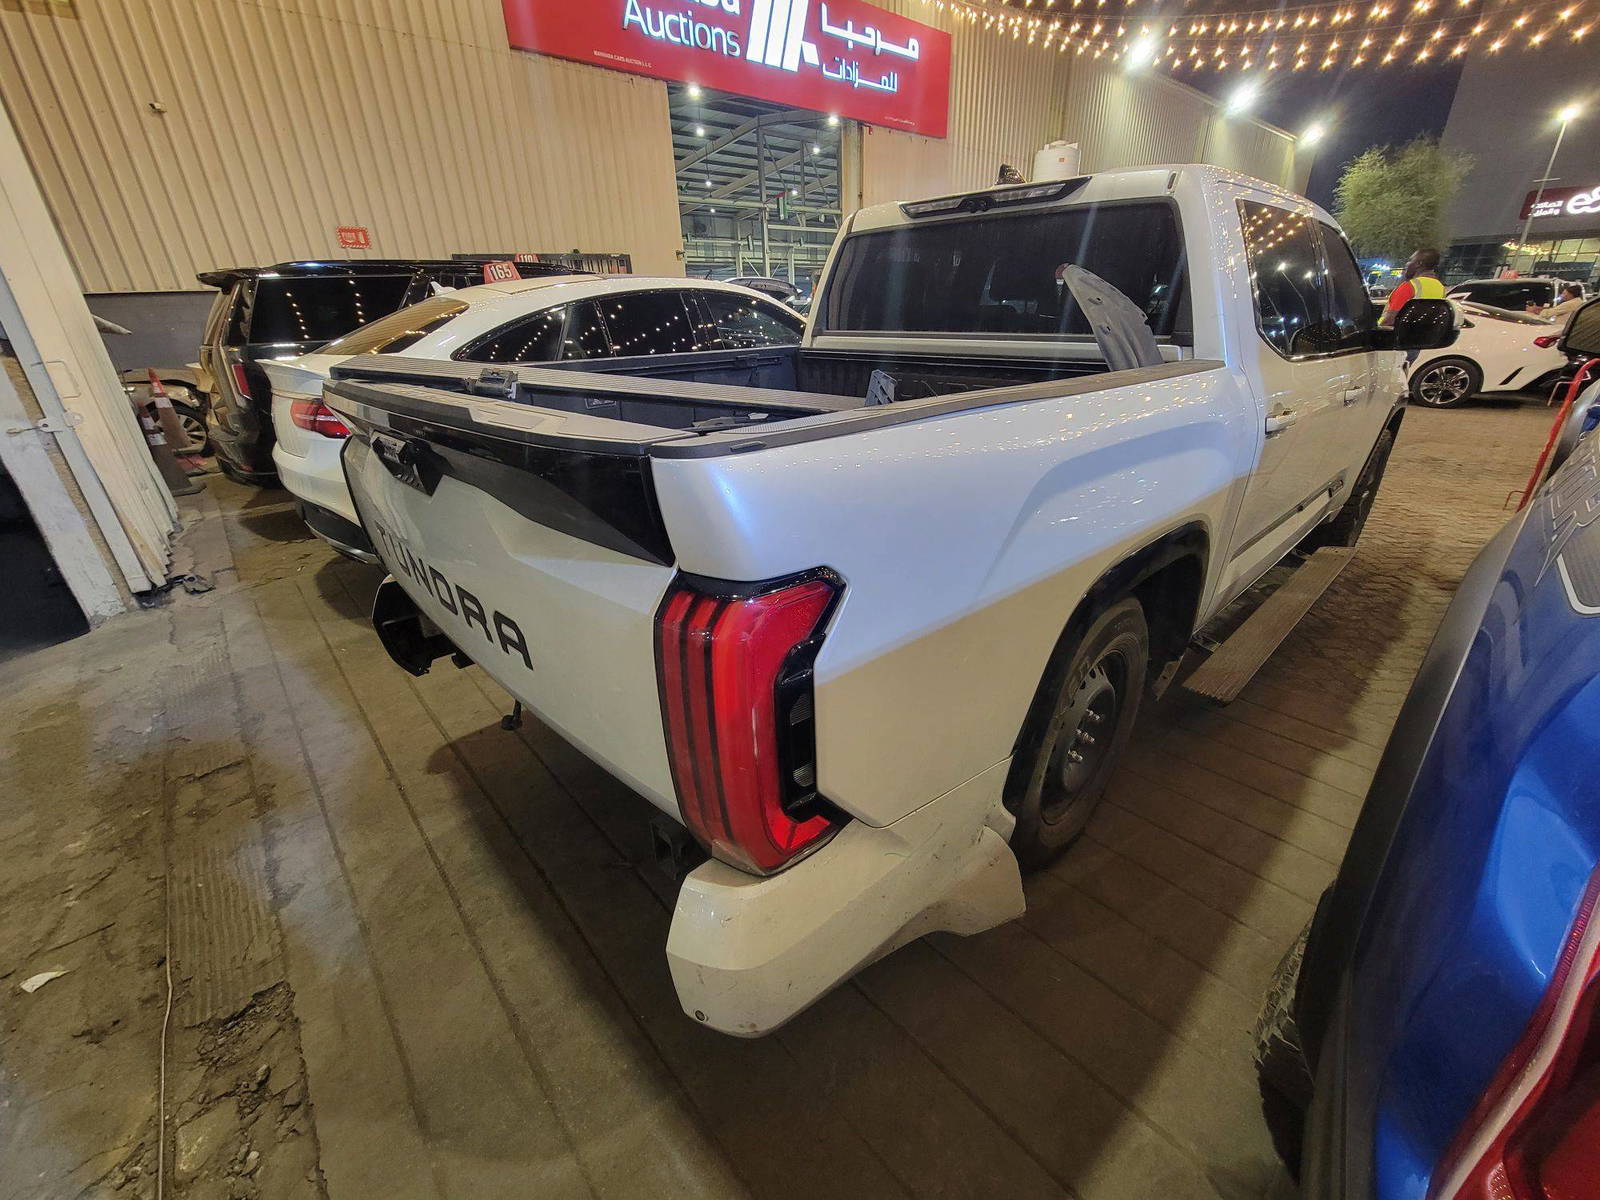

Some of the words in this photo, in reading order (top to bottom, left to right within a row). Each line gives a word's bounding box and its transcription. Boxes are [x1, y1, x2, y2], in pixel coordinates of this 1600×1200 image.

[622, 0, 741, 57] Auctions
[821, 2, 919, 59] مرحبا
[822, 56, 897, 92] للمزادات
[490, 263, 512, 280] 165
[374, 519, 534, 671] TUNDRA
